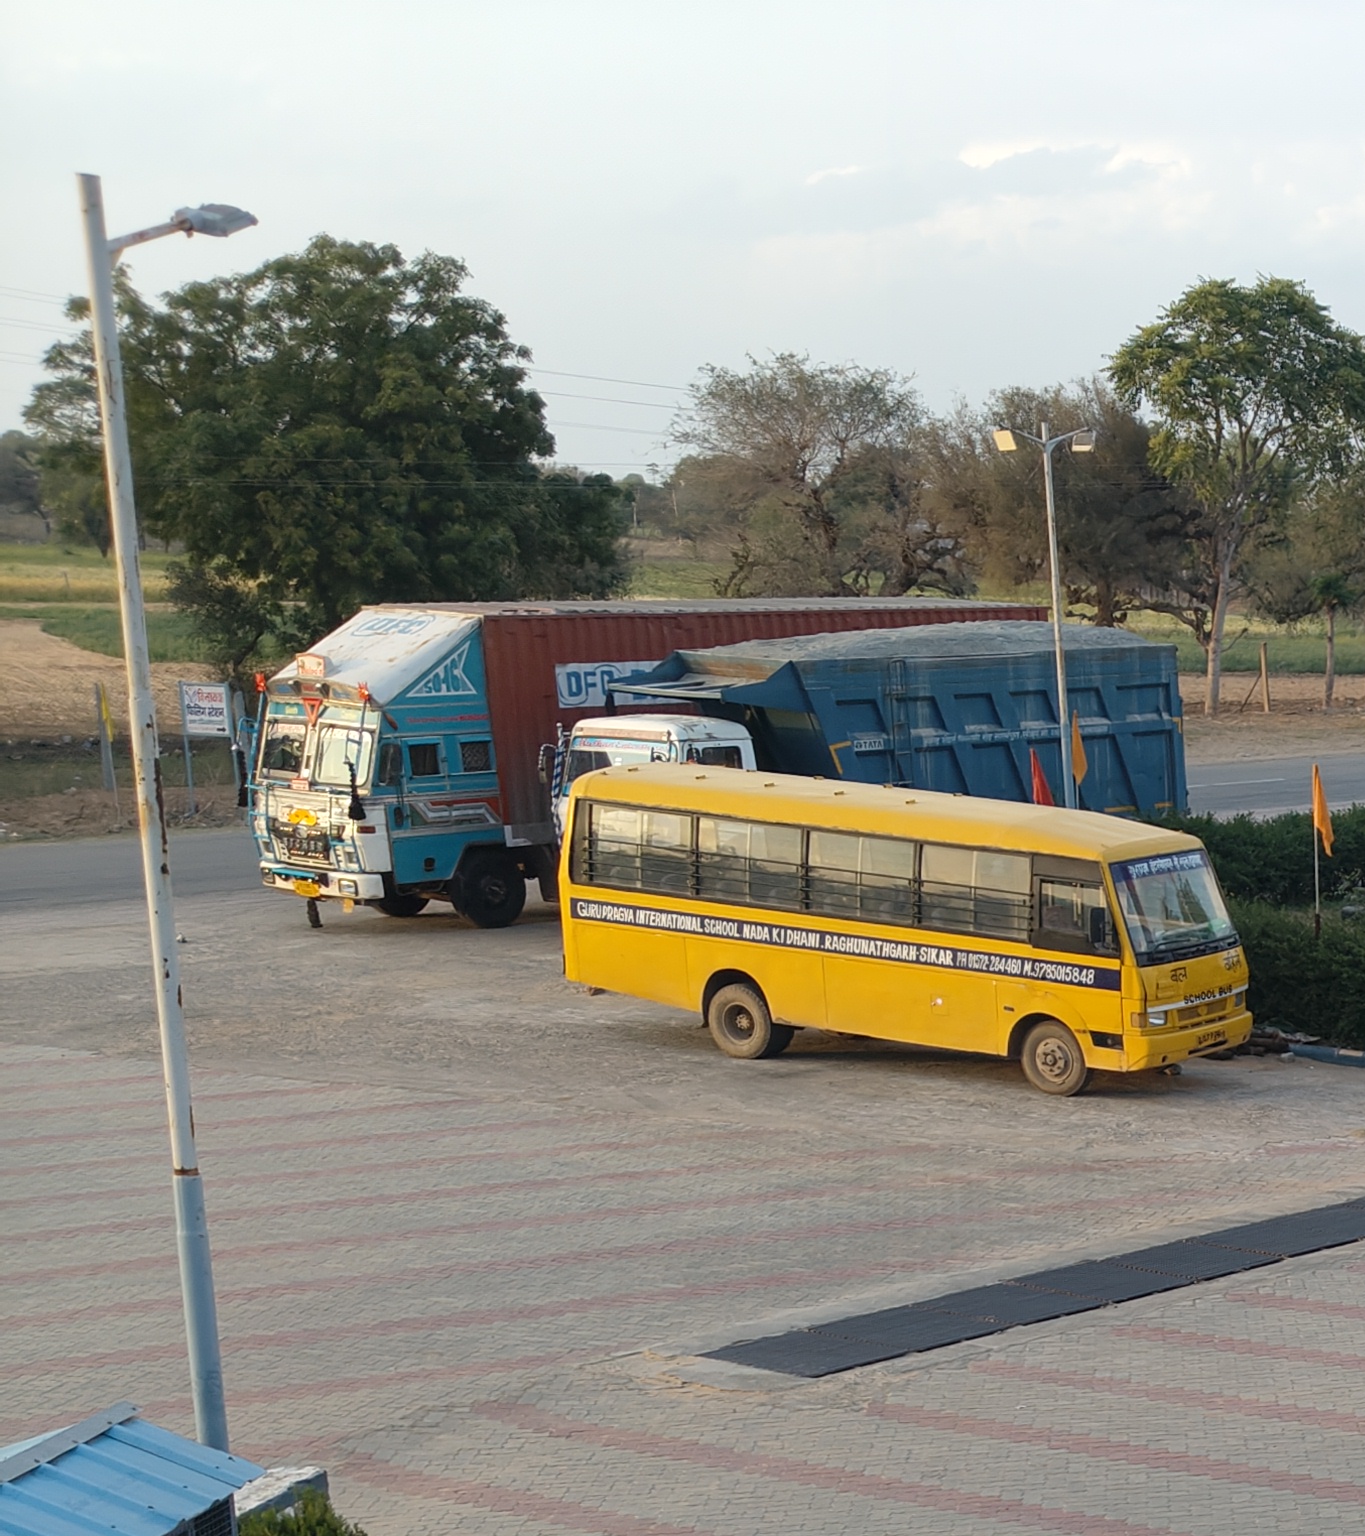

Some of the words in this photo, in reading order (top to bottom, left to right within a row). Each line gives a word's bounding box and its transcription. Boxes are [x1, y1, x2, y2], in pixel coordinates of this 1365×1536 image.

[863, 741, 884, 749] TATA
[635, 908, 703, 934] INTERNATIONAL
[704, 918, 740, 938] SCHOOL
[743, 923, 771, 942] NADA
[956, 951, 967, 967] PH
[1184, 990, 1216, 1005] SCHOOL
[1218, 984, 1233, 997] BUS
